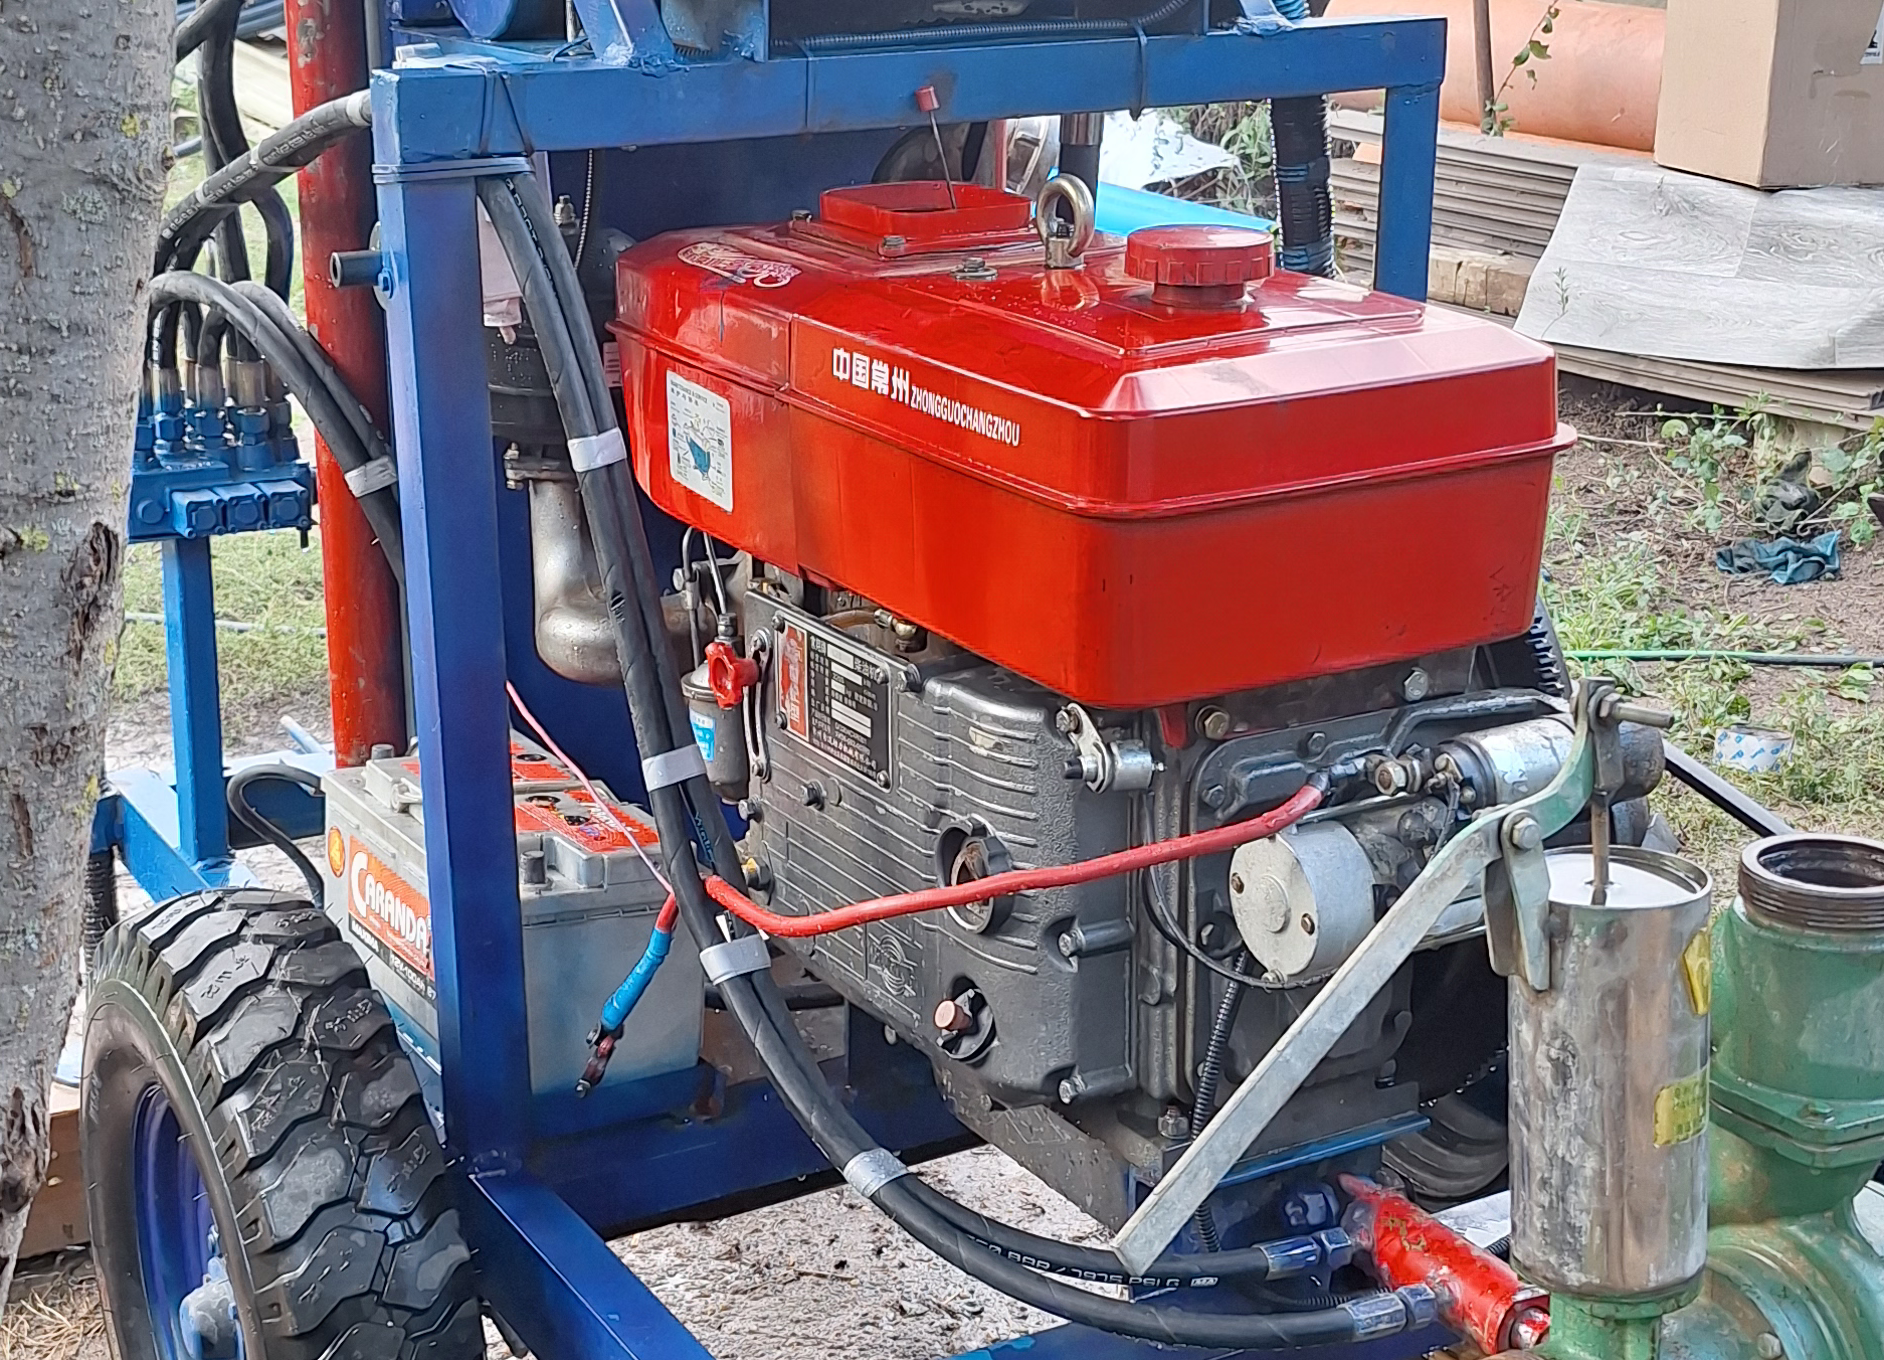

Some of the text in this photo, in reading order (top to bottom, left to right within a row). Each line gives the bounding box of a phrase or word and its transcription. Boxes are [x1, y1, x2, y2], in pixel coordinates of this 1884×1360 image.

[832, 347, 910, 405] 中国常州
[910, 385, 1021, 447] ZHONGGUOCHANGZHOU
[351, 851, 428, 955] CARANDA
